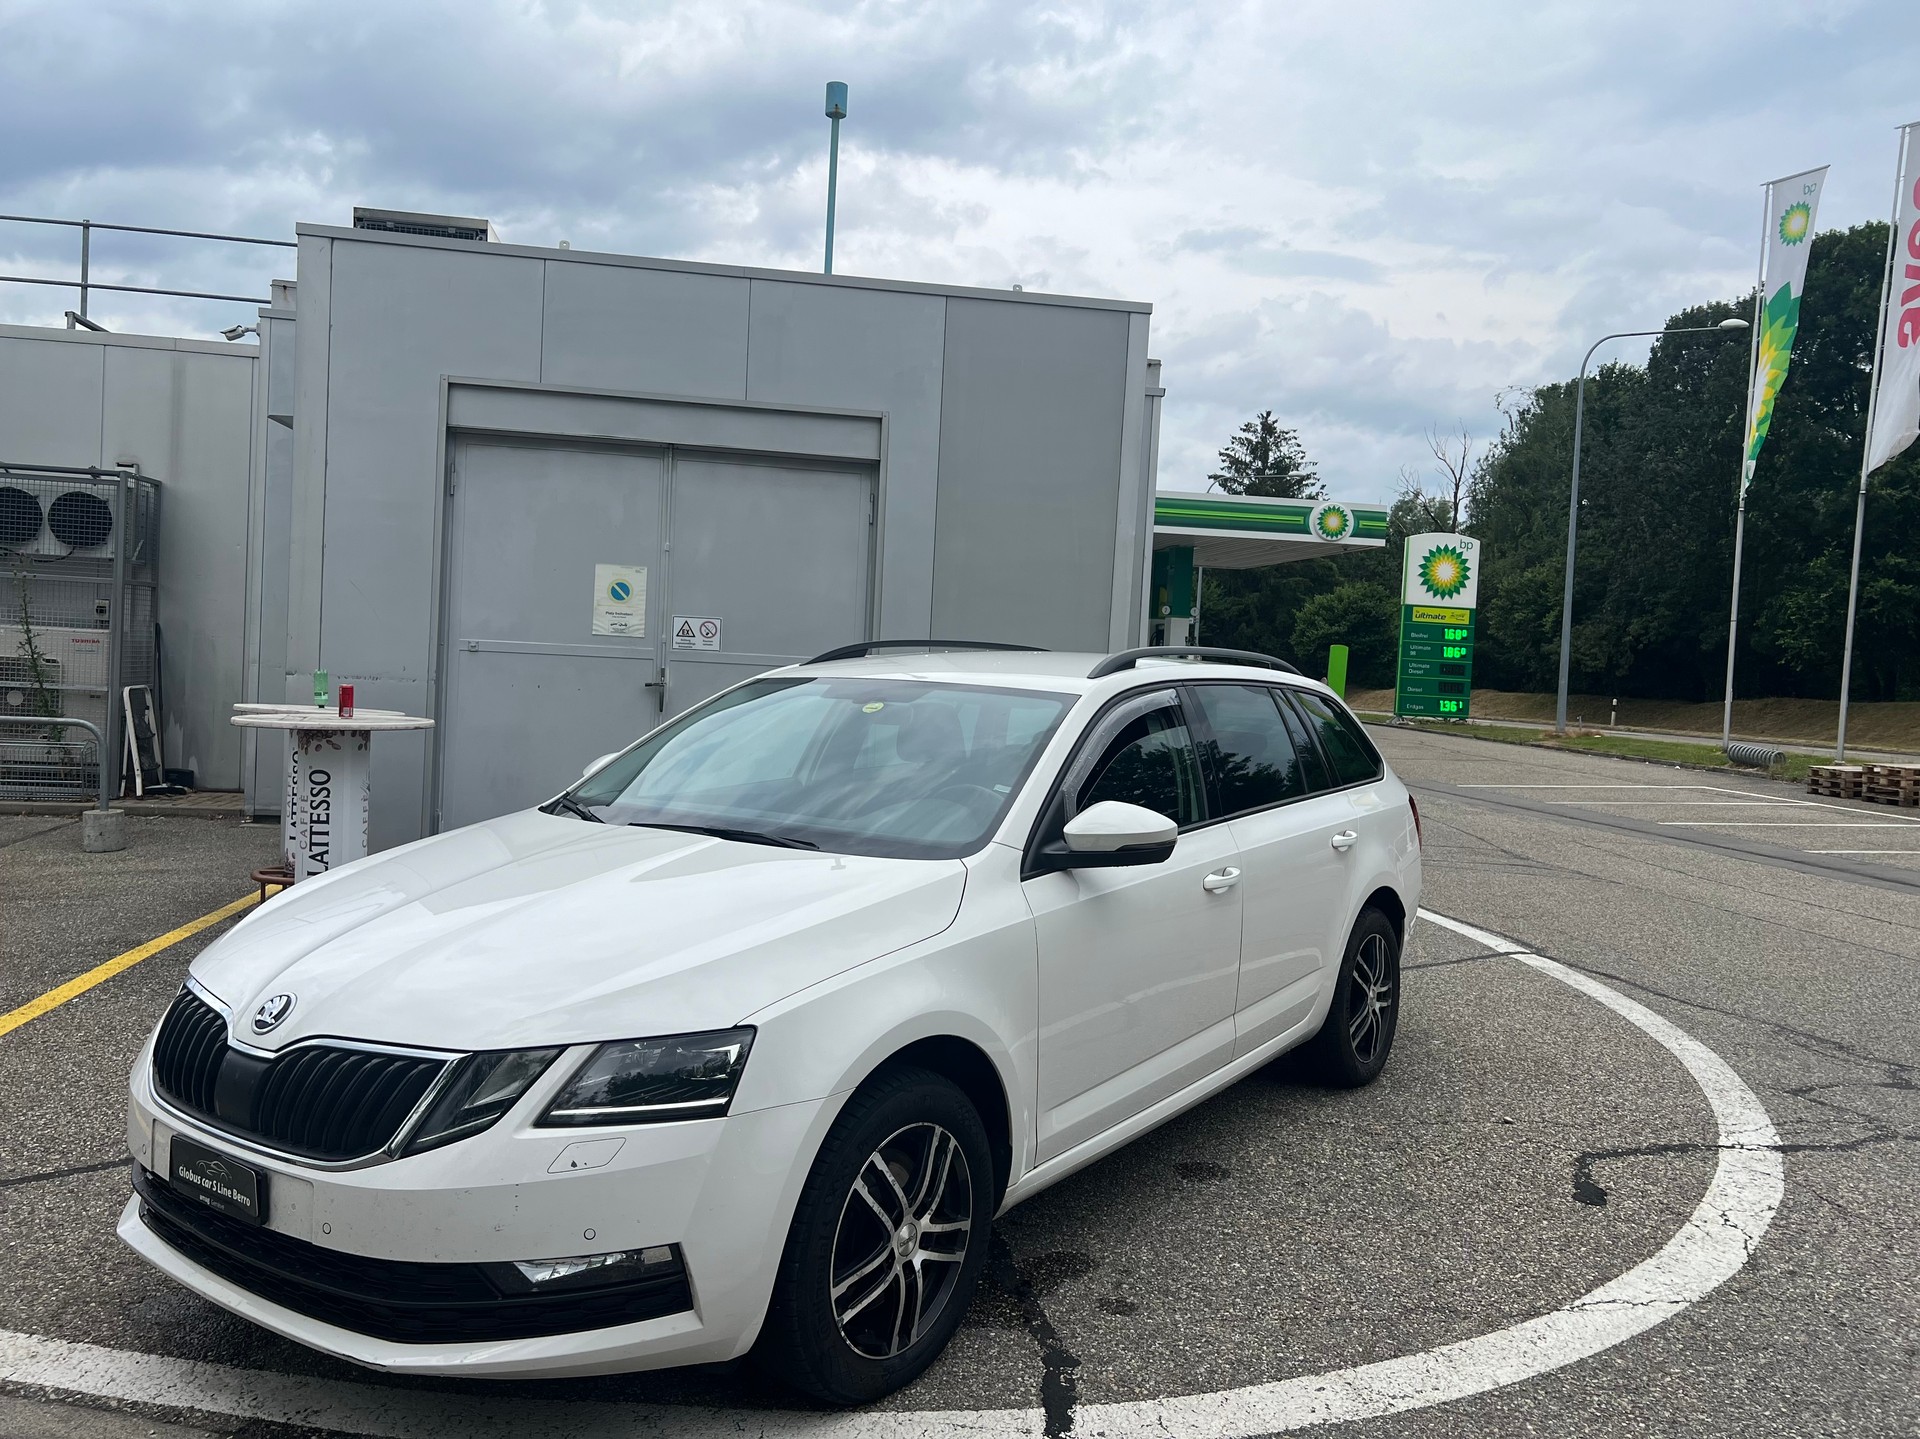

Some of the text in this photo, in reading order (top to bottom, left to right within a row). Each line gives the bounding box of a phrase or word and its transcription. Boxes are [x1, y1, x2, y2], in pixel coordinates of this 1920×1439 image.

[1803, 182, 1817, 195] bp
[1460, 539, 1474, 552] bp
[1415, 611, 1447, 620] ultimate
[299, 795, 309, 850] CAFFÈ
[306, 769, 331, 877] LATTESSO
[178, 1165, 201, 1185] Globus
[201, 1177, 212, 1189] car
[212, 1180, 217, 1192] S
[217, 1182, 232, 1198] Line
[232, 1188, 251, 1207] Berro
